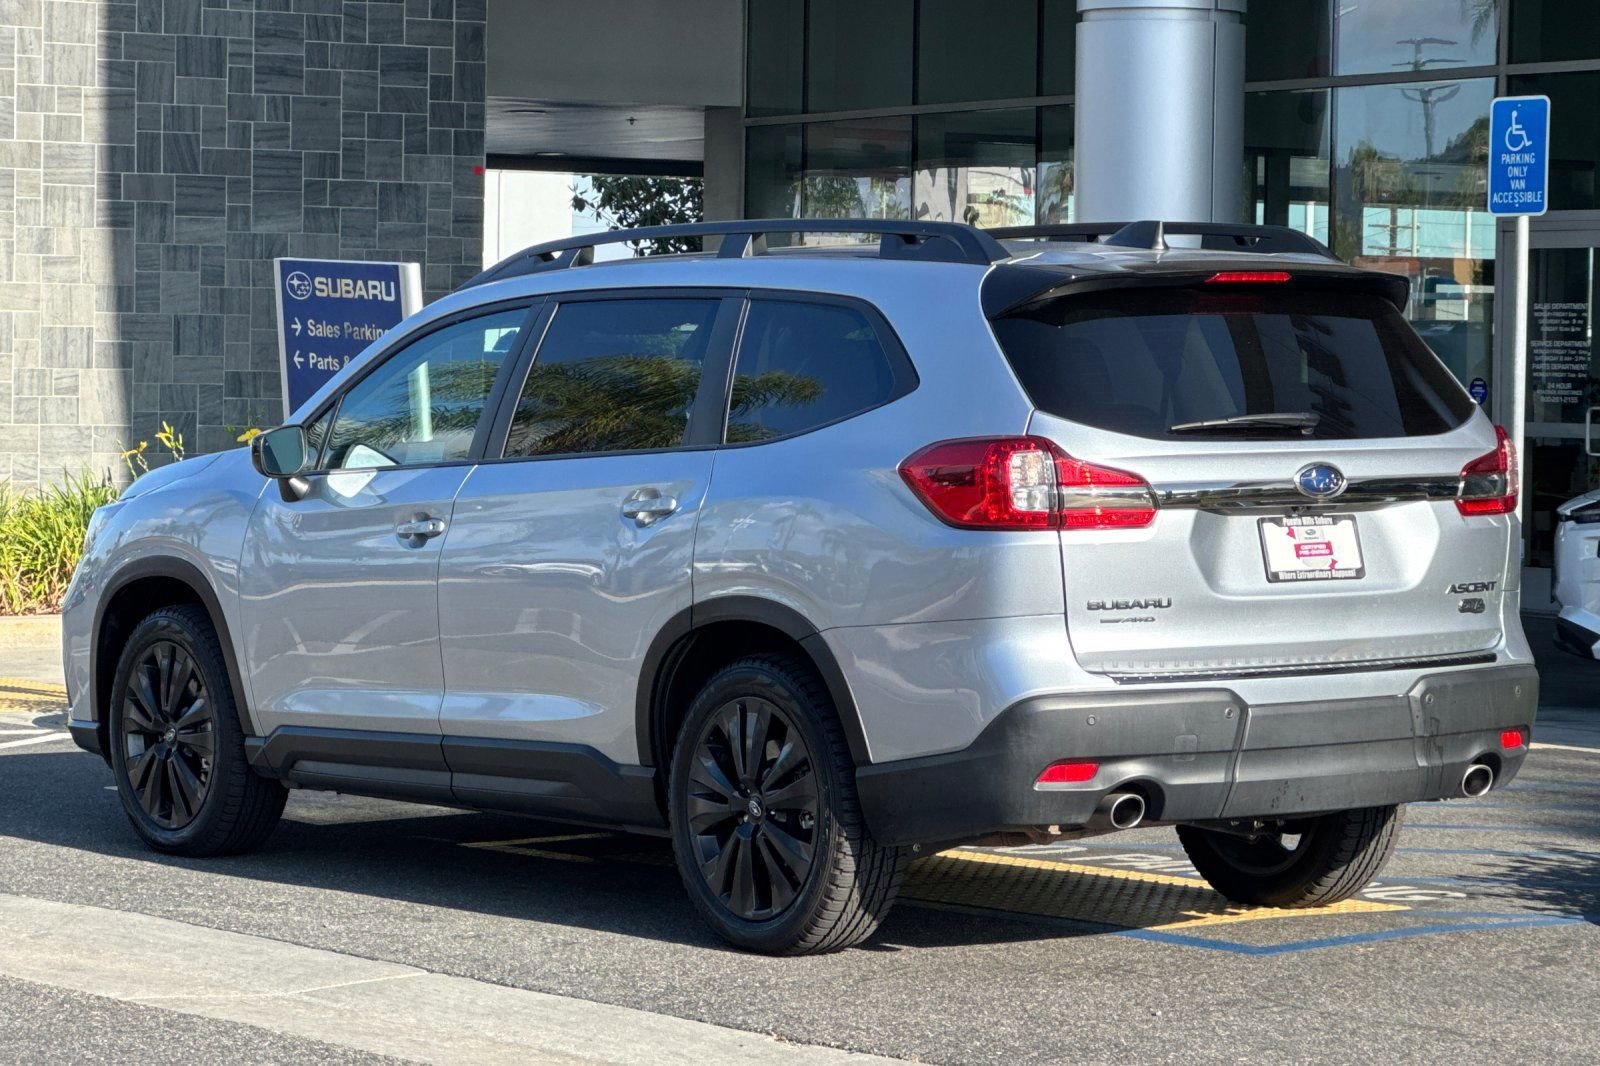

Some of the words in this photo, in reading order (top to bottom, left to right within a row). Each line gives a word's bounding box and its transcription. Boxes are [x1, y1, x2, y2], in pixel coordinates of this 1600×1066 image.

[1501, 152, 1536, 165] PARKING
[1507, 166, 1528, 178] ONLY
[1510, 179, 1526, 190] VAN
[1492, 191, 1542, 204] ACCESSIBLE
[314, 276, 396, 302] SUBARU
[307, 318, 341, 338] Sales
[344, 321, 390, 341] Parkin
[309, 353, 340, 371] Parts
[1445, 581, 1497, 594] ASCENT
[1086, 597, 1172, 611] SUBARU
